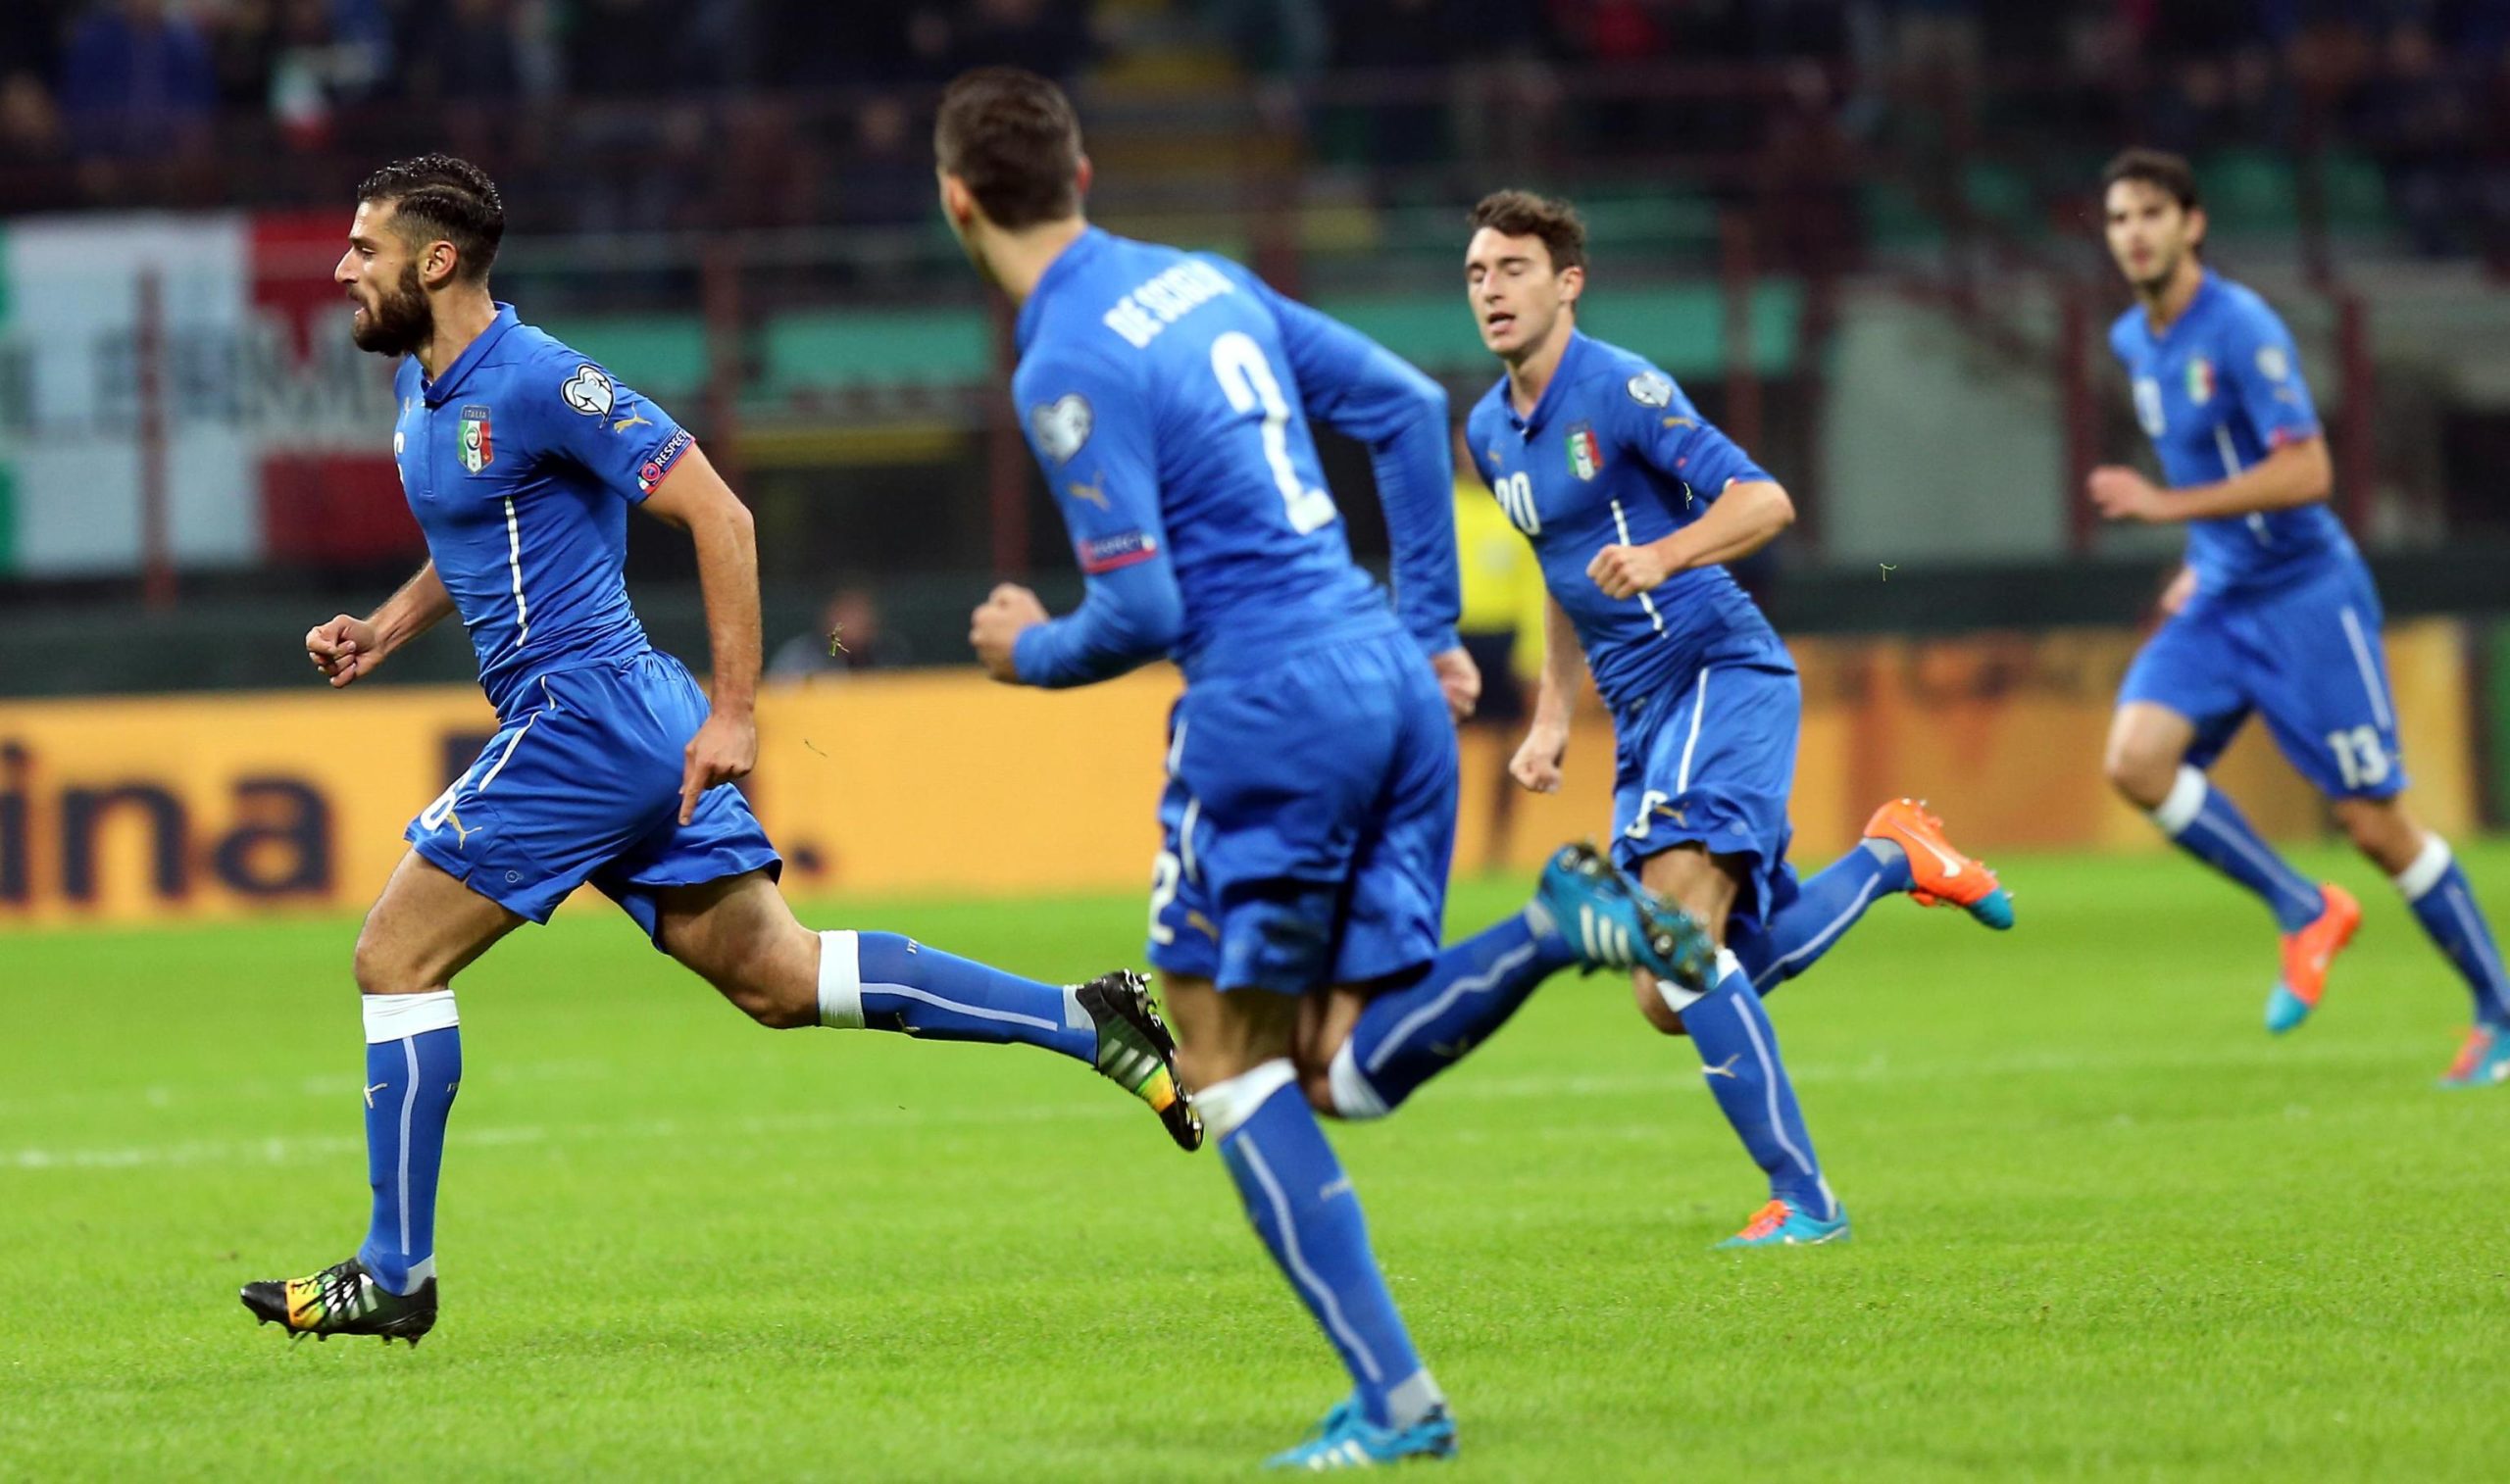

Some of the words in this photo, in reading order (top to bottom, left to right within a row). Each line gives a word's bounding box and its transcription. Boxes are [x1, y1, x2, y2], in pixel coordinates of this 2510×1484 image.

[1210, 329, 1336, 536] 2
[2326, 723, 2389, 790] 13
[1149, 849, 1180, 946] 2
